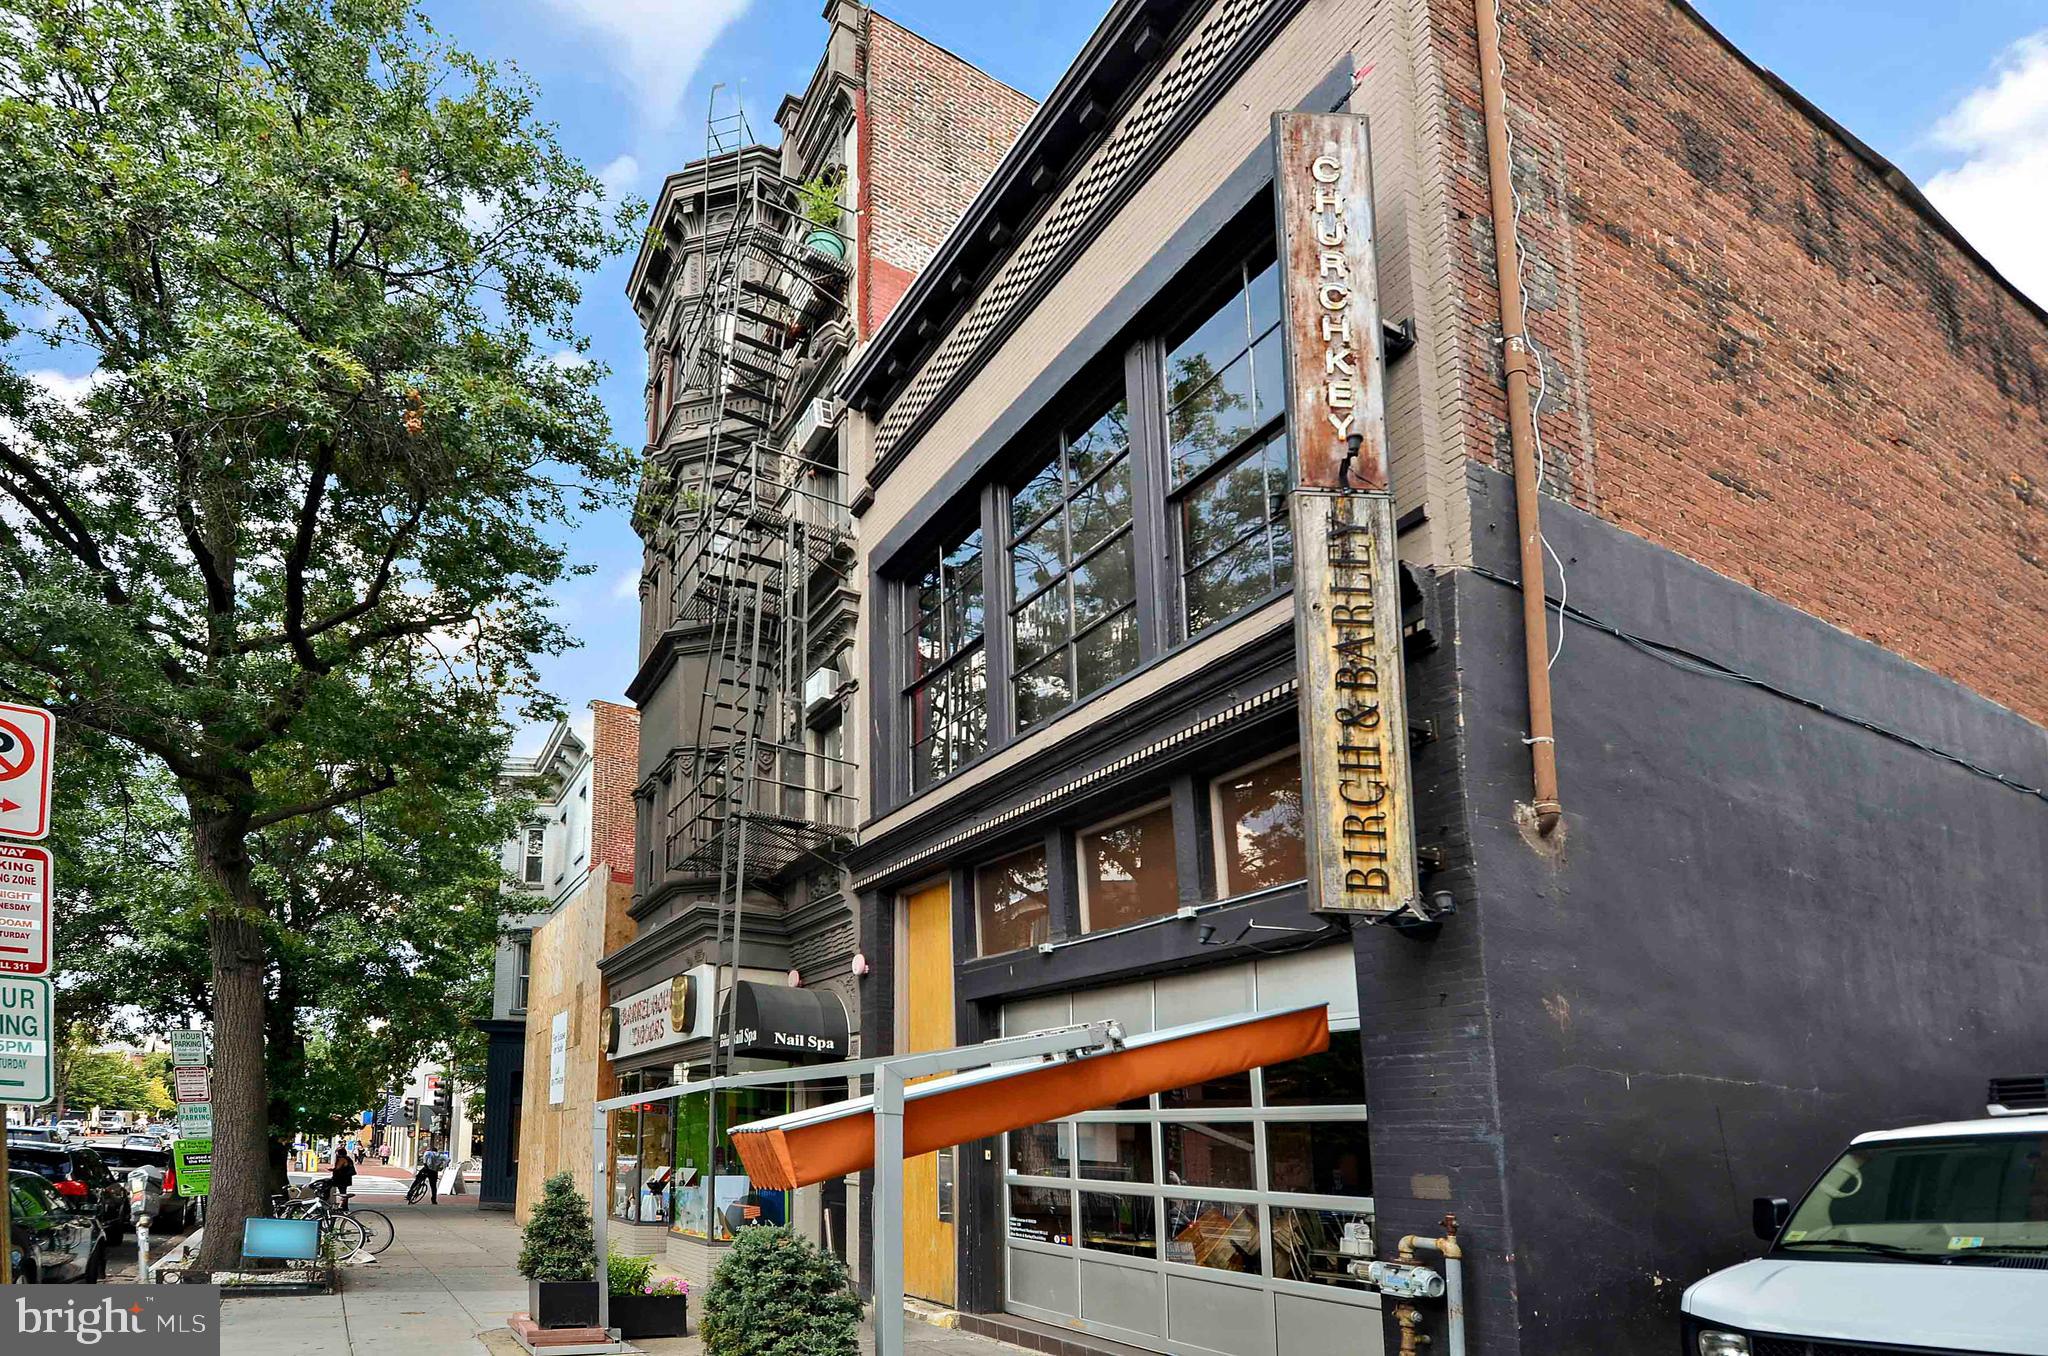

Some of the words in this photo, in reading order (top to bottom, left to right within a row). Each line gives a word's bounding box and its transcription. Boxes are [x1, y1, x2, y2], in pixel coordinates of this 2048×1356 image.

[1311, 155, 1354, 441] CHURCHKEY
[1325, 510, 1379, 691] BARLEY
[1335, 705, 1381, 730] &
[1337, 740, 1391, 895] BIRCH
[12, 875, 37, 886] ZONE
[13, 963, 29, 971] 311
[620, 997, 651, 1026] BARREL
[744, 1028, 757, 1047] Spa
[774, 1031, 805, 1047] Nail
[807, 1036, 835, 1052] Spa
[181, 1113, 211, 1121] PARKING
